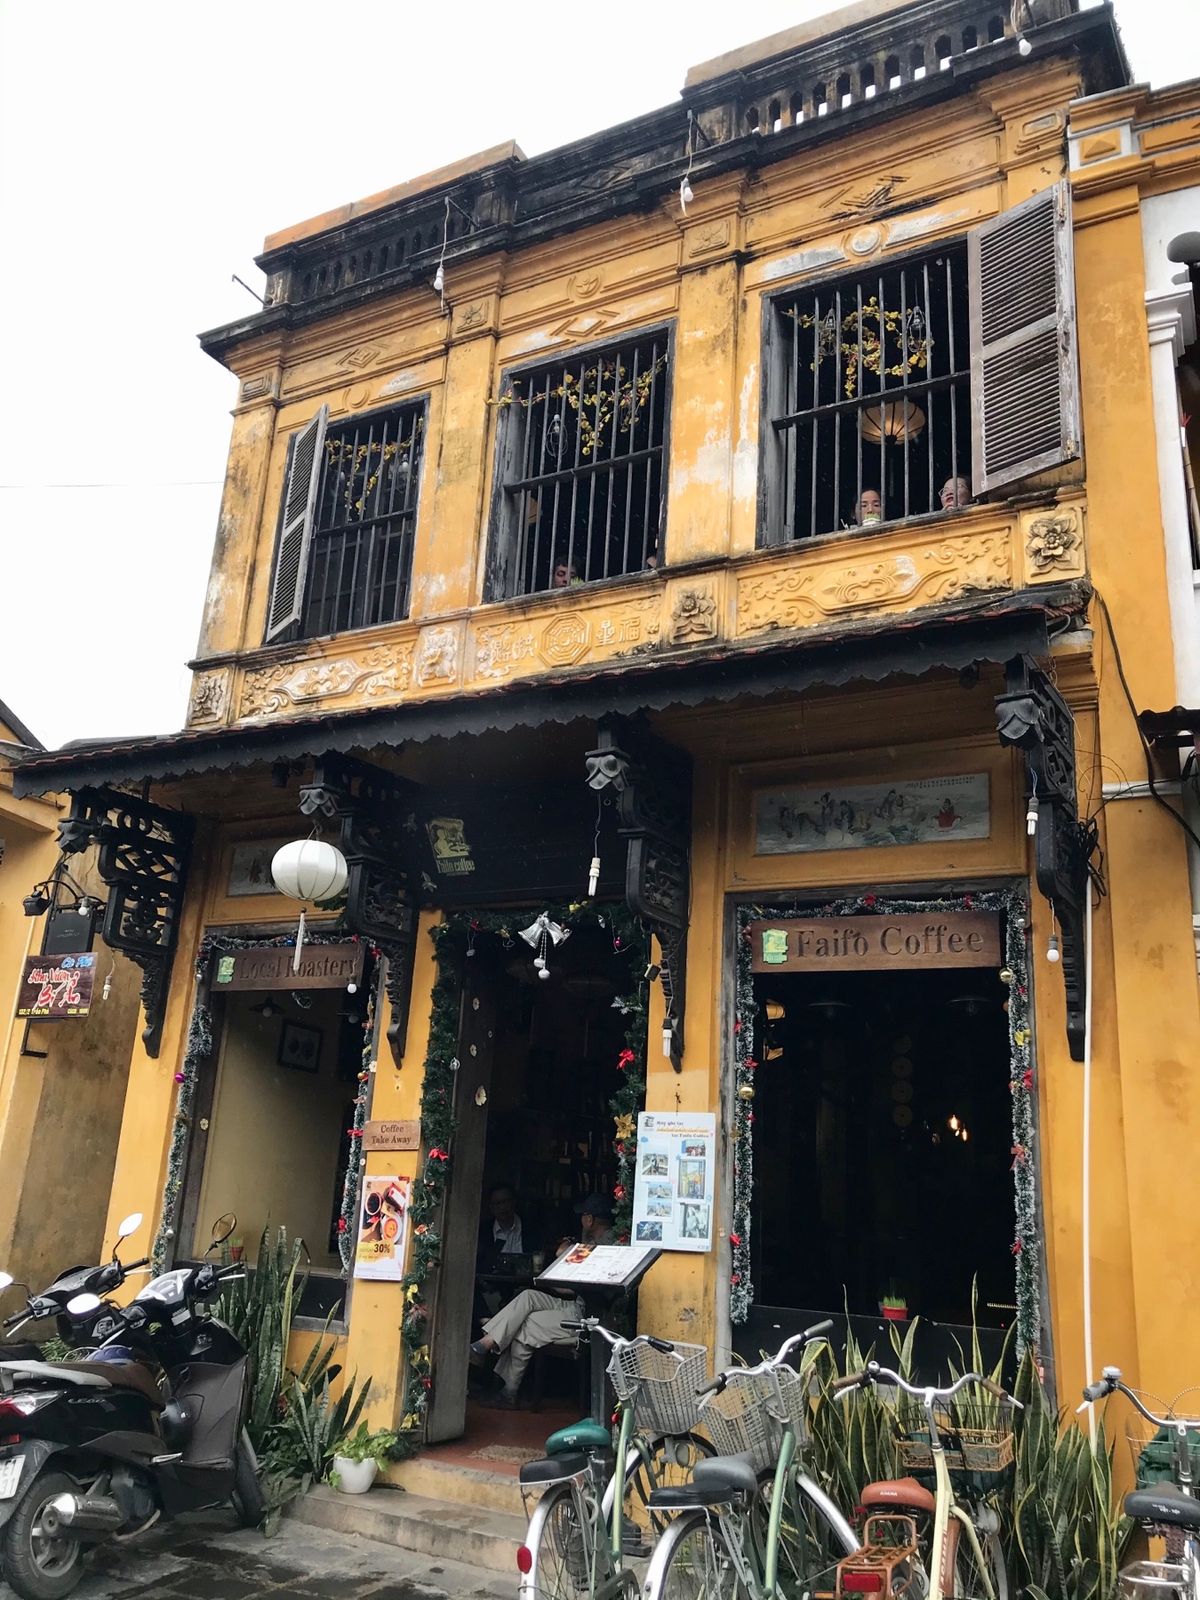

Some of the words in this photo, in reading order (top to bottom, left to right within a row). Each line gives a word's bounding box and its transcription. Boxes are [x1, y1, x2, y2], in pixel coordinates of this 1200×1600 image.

[880, 924, 984, 956] Coffee
[240, 957, 282, 978] Local
[380, 1124, 404, 1133] Coffee
[371, 1135, 390, 1144] Take
[390, 1135, 412, 1145] Away
[373, 1243, 390, 1254] 30%
